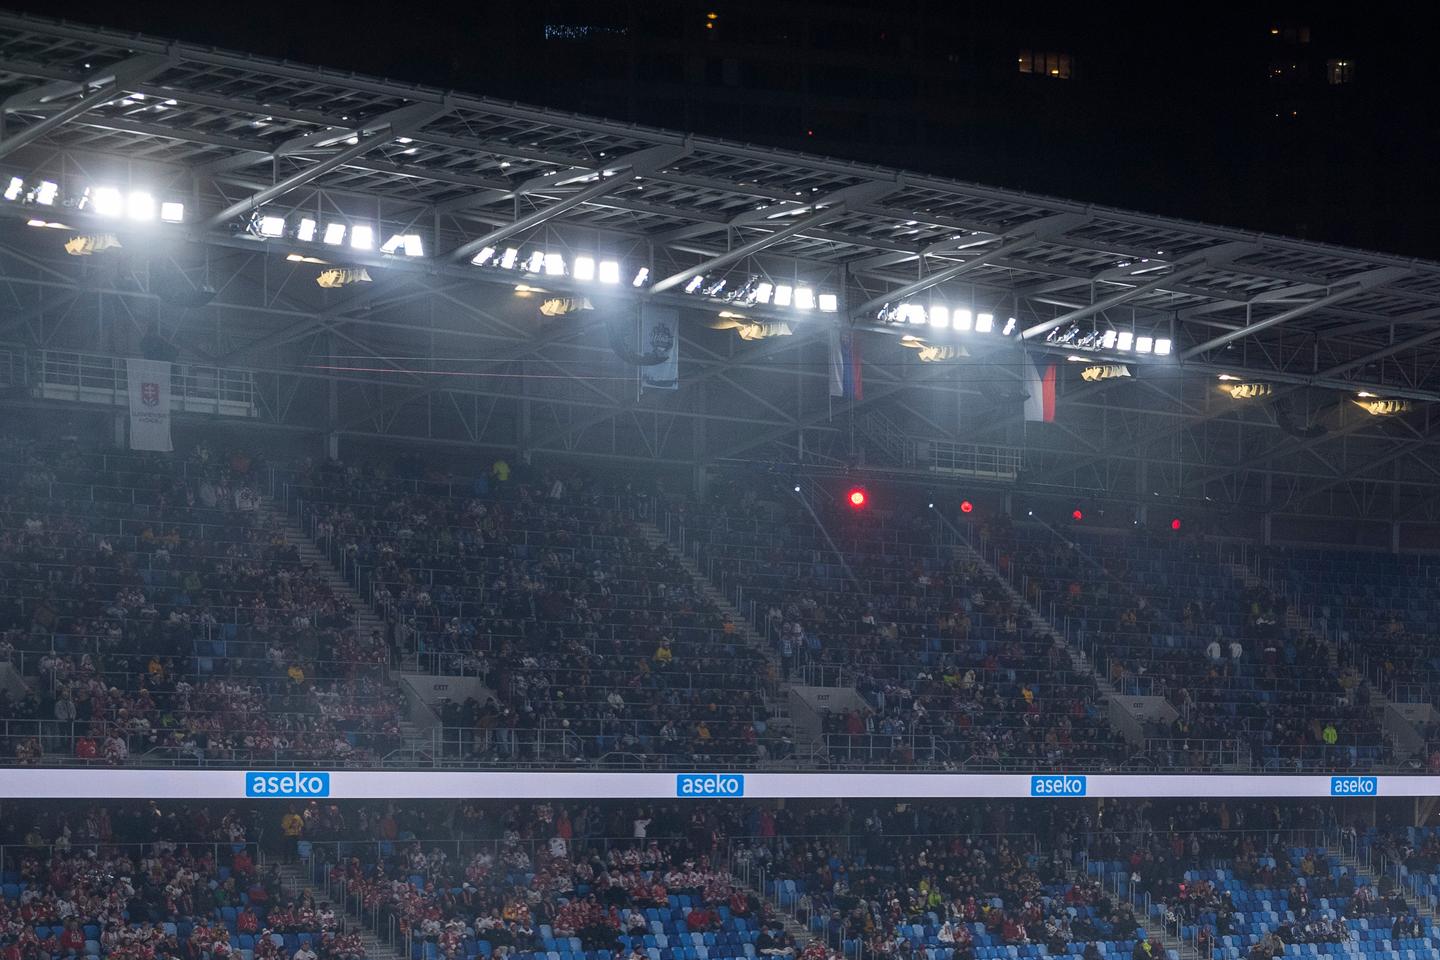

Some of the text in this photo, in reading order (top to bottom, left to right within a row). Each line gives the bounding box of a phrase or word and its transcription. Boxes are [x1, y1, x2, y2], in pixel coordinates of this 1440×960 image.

[252, 773, 323, 794] aseko
[682, 775, 739, 794] aseko
[1035, 776, 1082, 795] aseko
[1334, 777, 1374, 794] aseko
